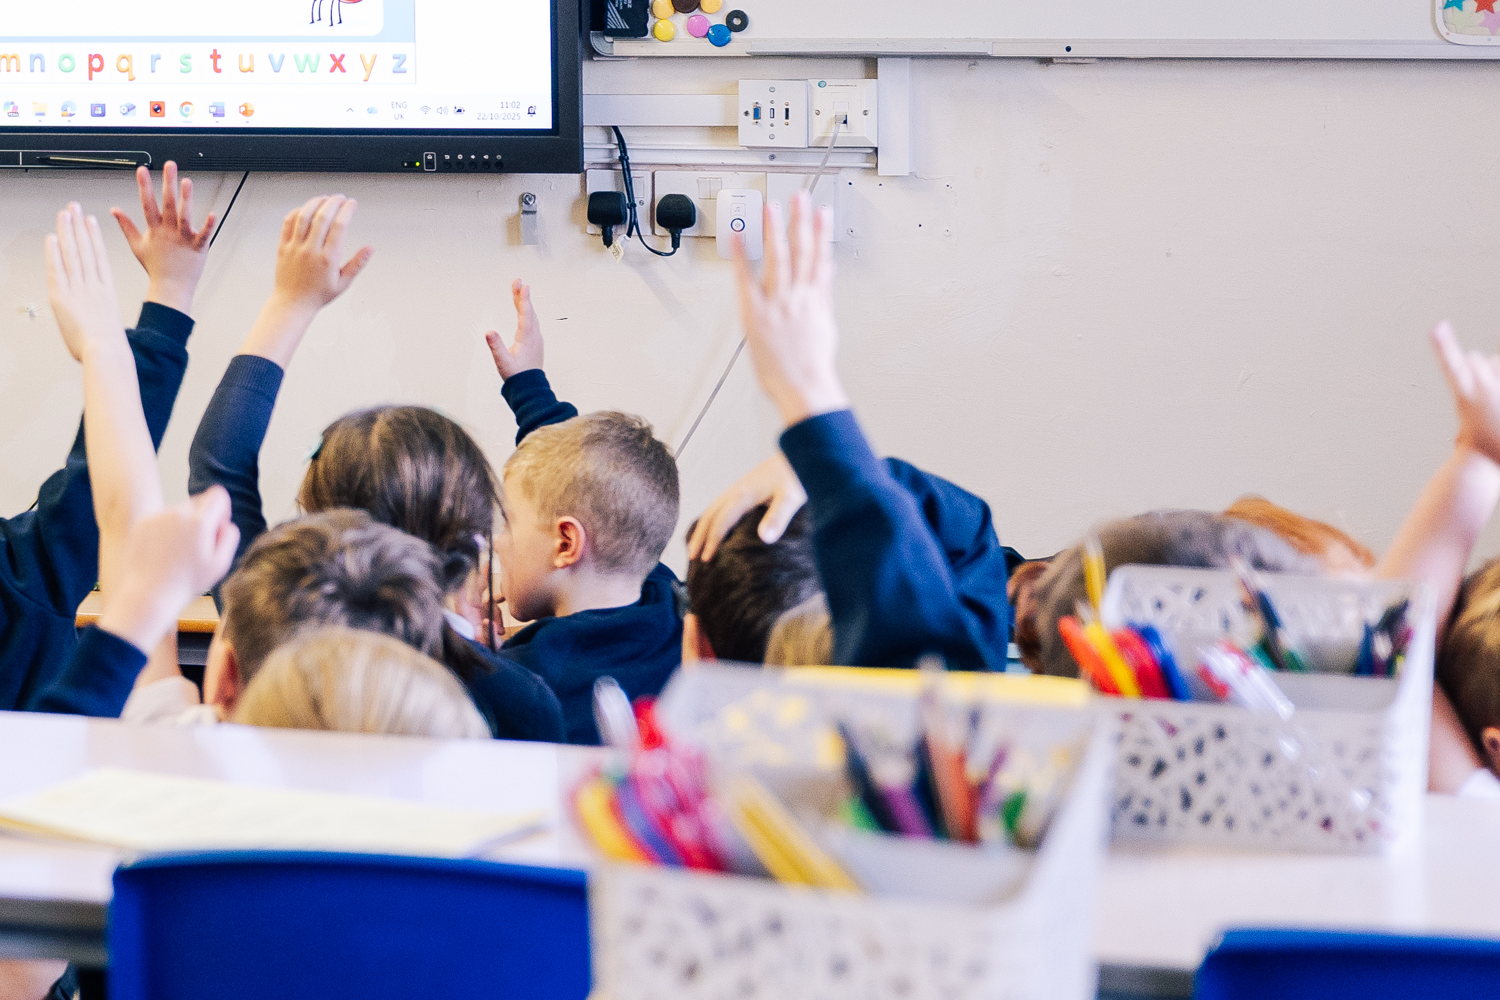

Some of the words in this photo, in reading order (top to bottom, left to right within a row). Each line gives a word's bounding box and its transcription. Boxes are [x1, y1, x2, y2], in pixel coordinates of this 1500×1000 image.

[29, 53, 45, 72] n
[58, 53, 76, 73] o
[88, 53, 104, 81] p
[116, 53, 136, 81] q
[151, 53, 161, 73] r
[179, 53, 192, 73] s
[210, 49, 222, 73] t
[238, 53, 254, 73] u
[268, 53, 285, 73] v
[294, 53, 320, 73] w
[329, 53, 347, 73] x
[360, 53, 377, 82] y
[392, 53, 407, 73] z
[391, 101, 408, 109] ENG
[500, 101, 521, 109] 11:02
[394, 113, 405, 121] UK
[477, 113, 521, 121] 22/10/2025
